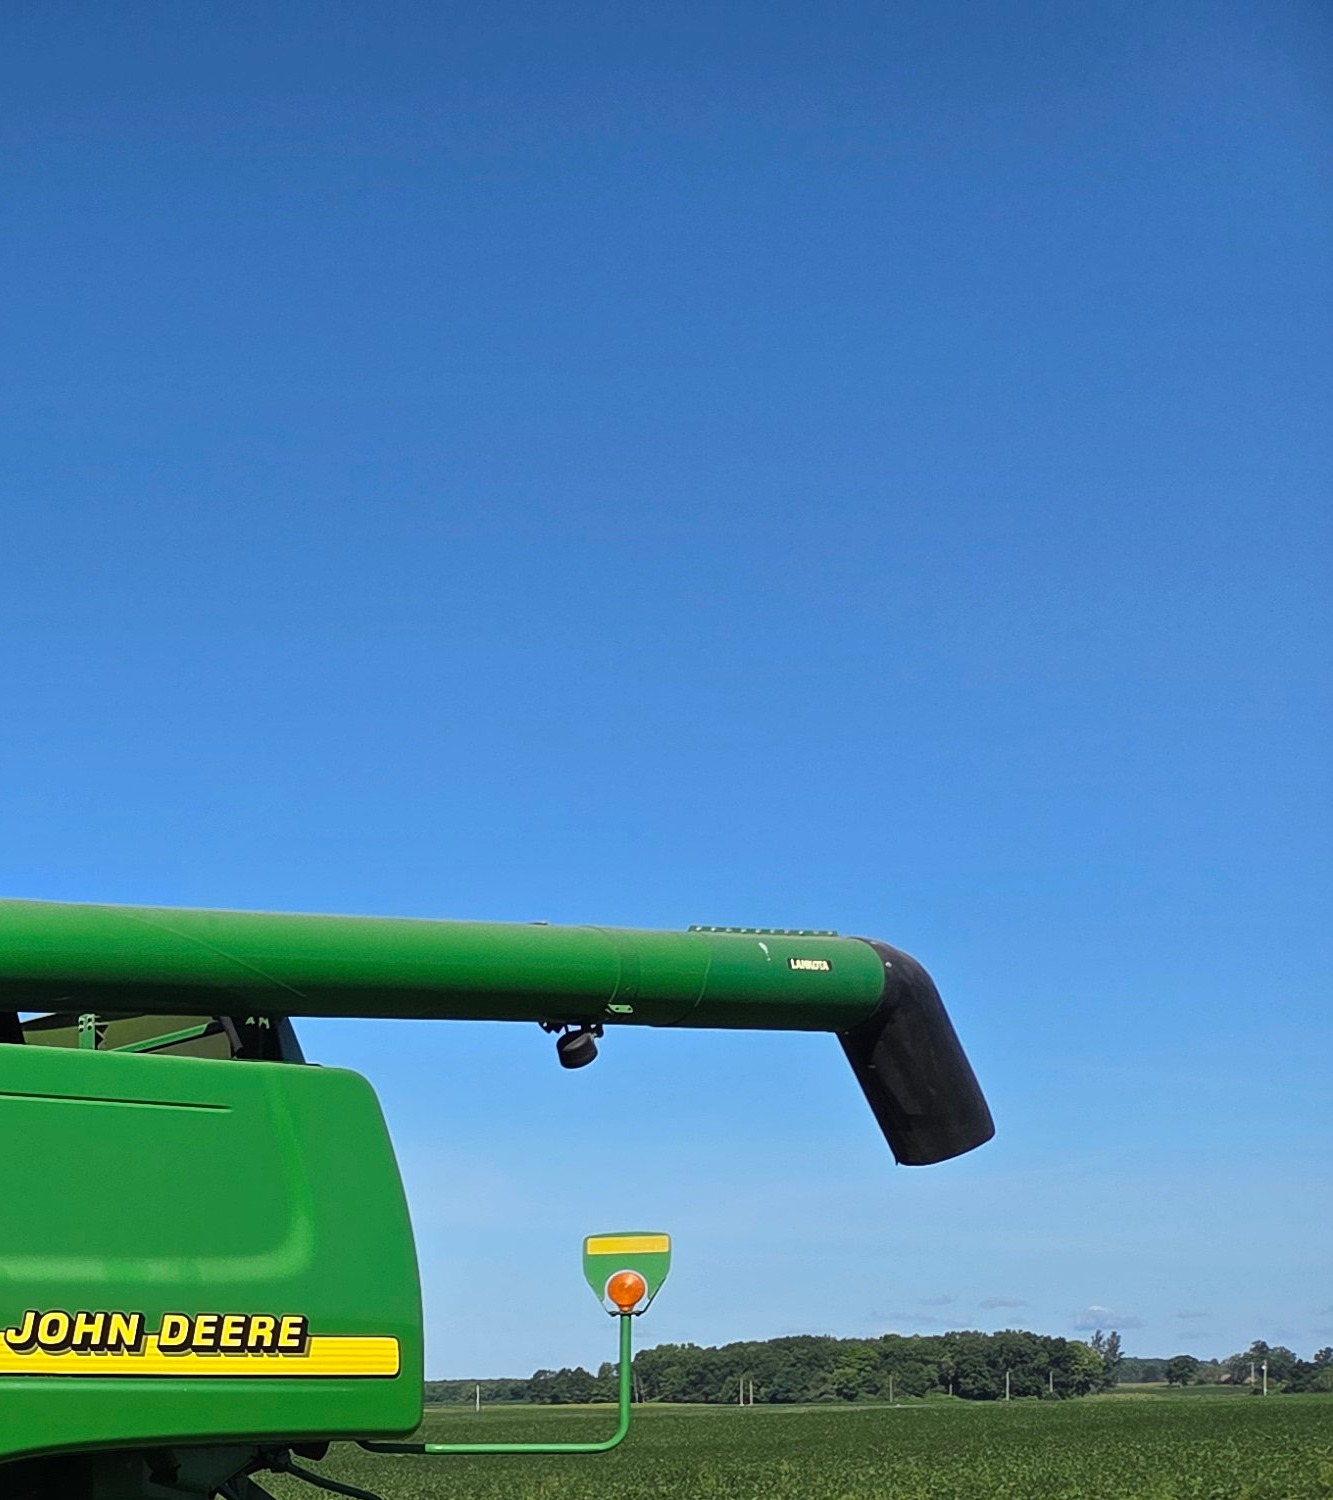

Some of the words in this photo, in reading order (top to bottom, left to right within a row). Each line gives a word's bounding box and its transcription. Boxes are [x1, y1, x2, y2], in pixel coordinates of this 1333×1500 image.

[790, 958, 830, 971] LANKOTA
[4, 1310, 147, 1353] JOHN
[156, 1313, 310, 1355] DEERE
